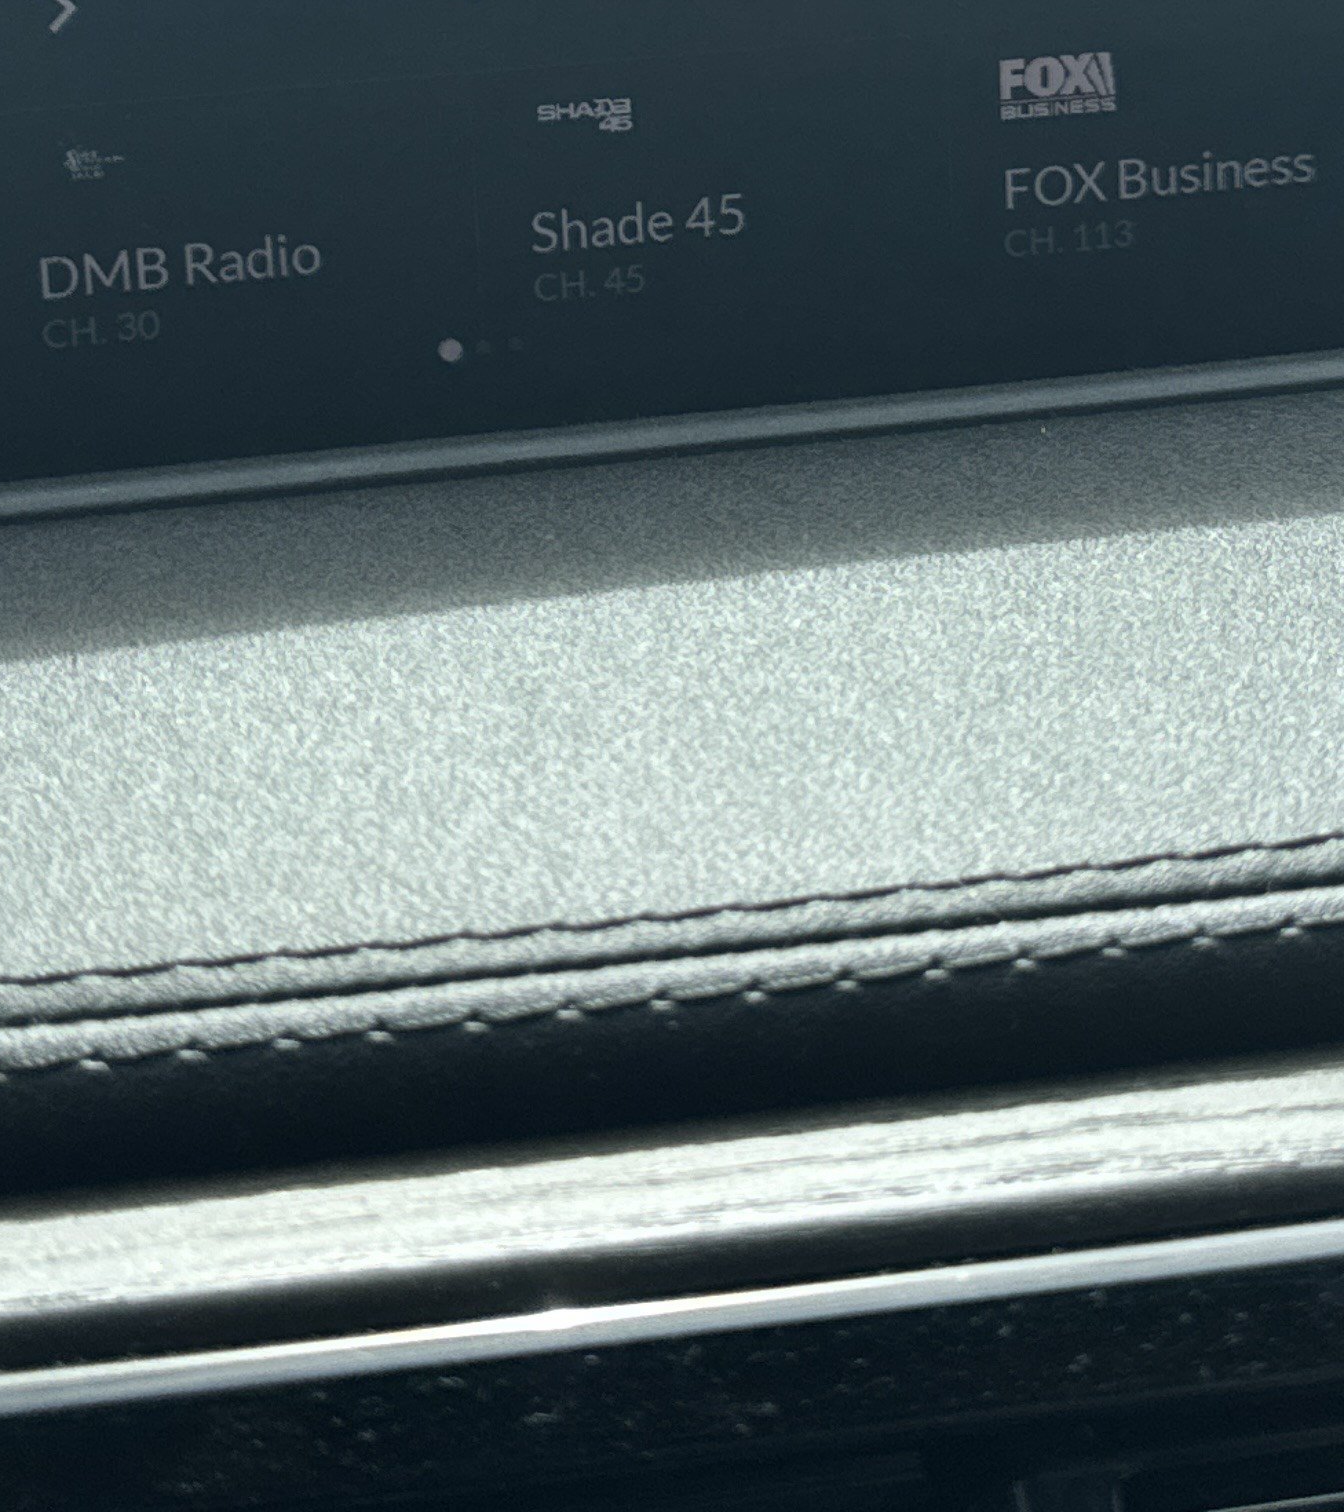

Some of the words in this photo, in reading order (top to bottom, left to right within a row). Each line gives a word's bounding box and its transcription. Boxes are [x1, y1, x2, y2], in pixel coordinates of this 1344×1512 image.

[598, 115, 634, 132] 45
[999, 97, 1118, 121] BUSINESS
[1004, 159, 1109, 211] FOX
[1117, 150, 1316, 200] Business
[530, 200, 674, 254] Shade
[684, 192, 746, 238] 45
[1004, 224, 1065, 257] CH.
[1073, 219, 1138, 253] 113
[38, 246, 170, 301] DMB
[183, 233, 322, 286] Radio
[533, 270, 597, 302] CH.
[603, 264, 647, 296] 45
[41, 316, 109, 349] CH.
[115, 309, 161, 344] 30
